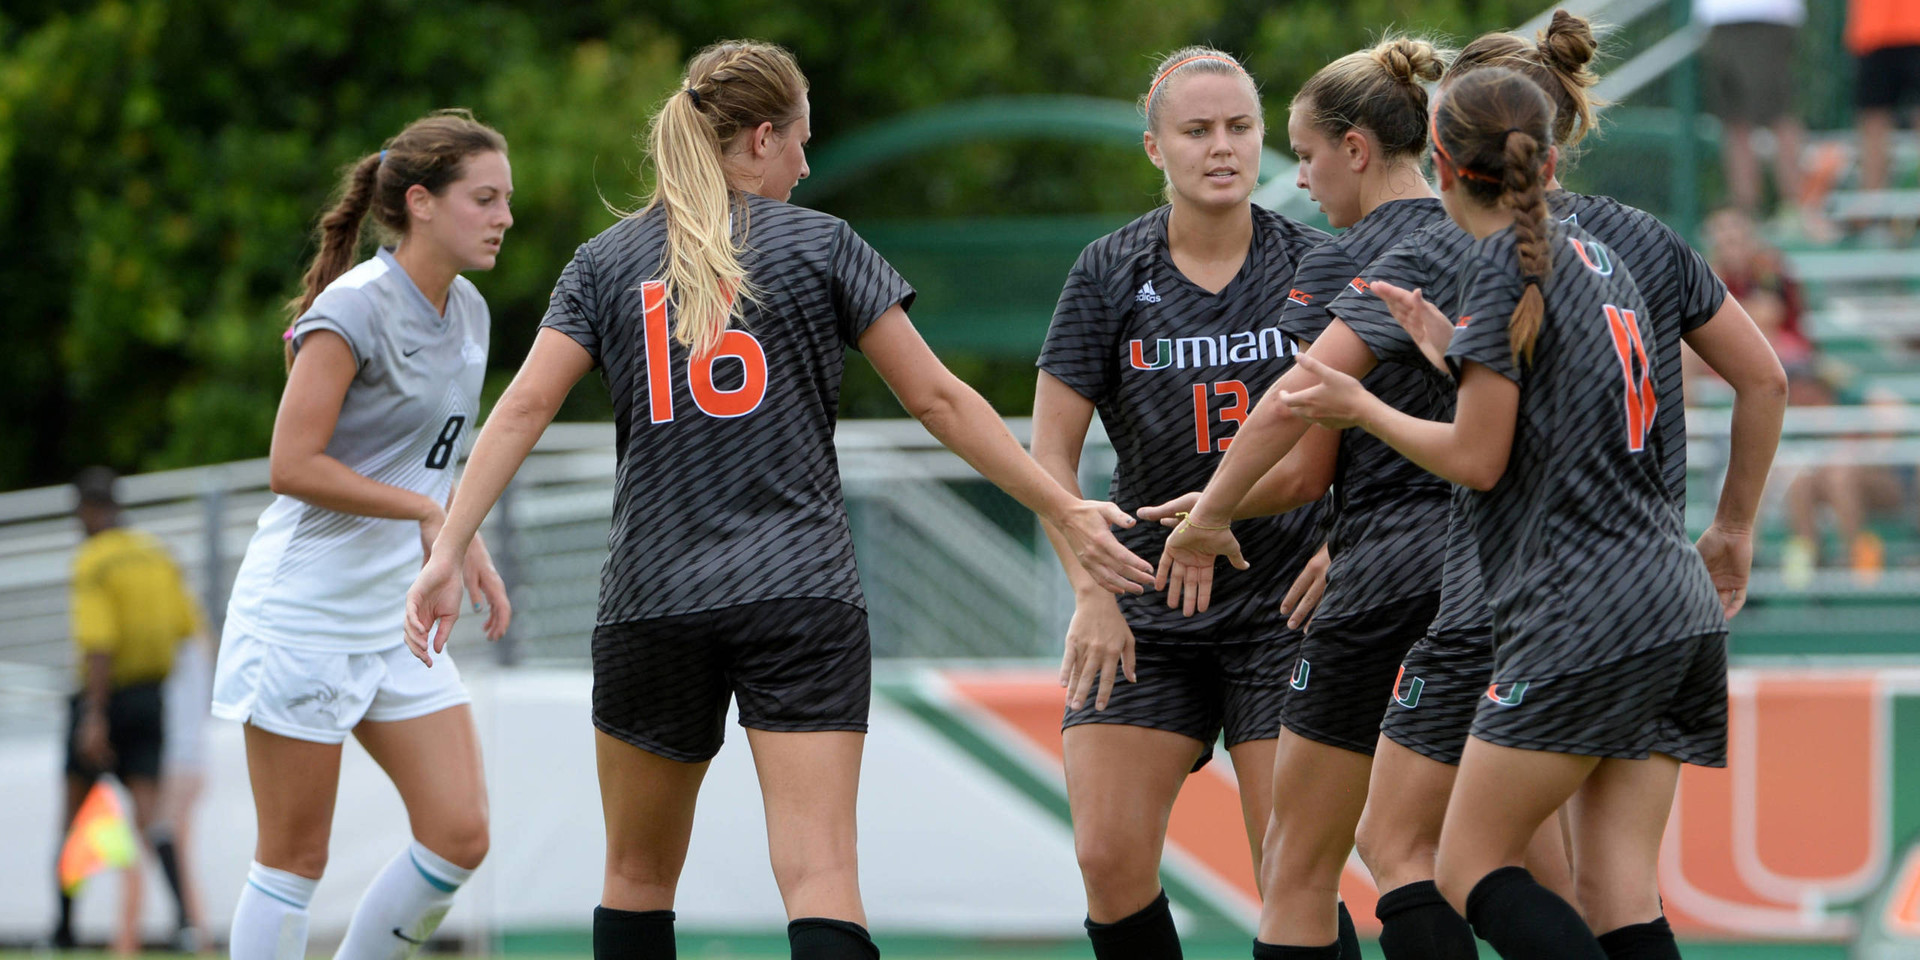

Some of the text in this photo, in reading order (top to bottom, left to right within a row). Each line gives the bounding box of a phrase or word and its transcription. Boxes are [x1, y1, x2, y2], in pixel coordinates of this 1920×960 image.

[1568, 237, 1613, 276] U
[641, 276, 768, 424] 16
[1602, 304, 1658, 452] 11
[425, 415, 466, 470] 8
[1193, 379, 1250, 454] 13
[1393, 664, 1426, 709] U
